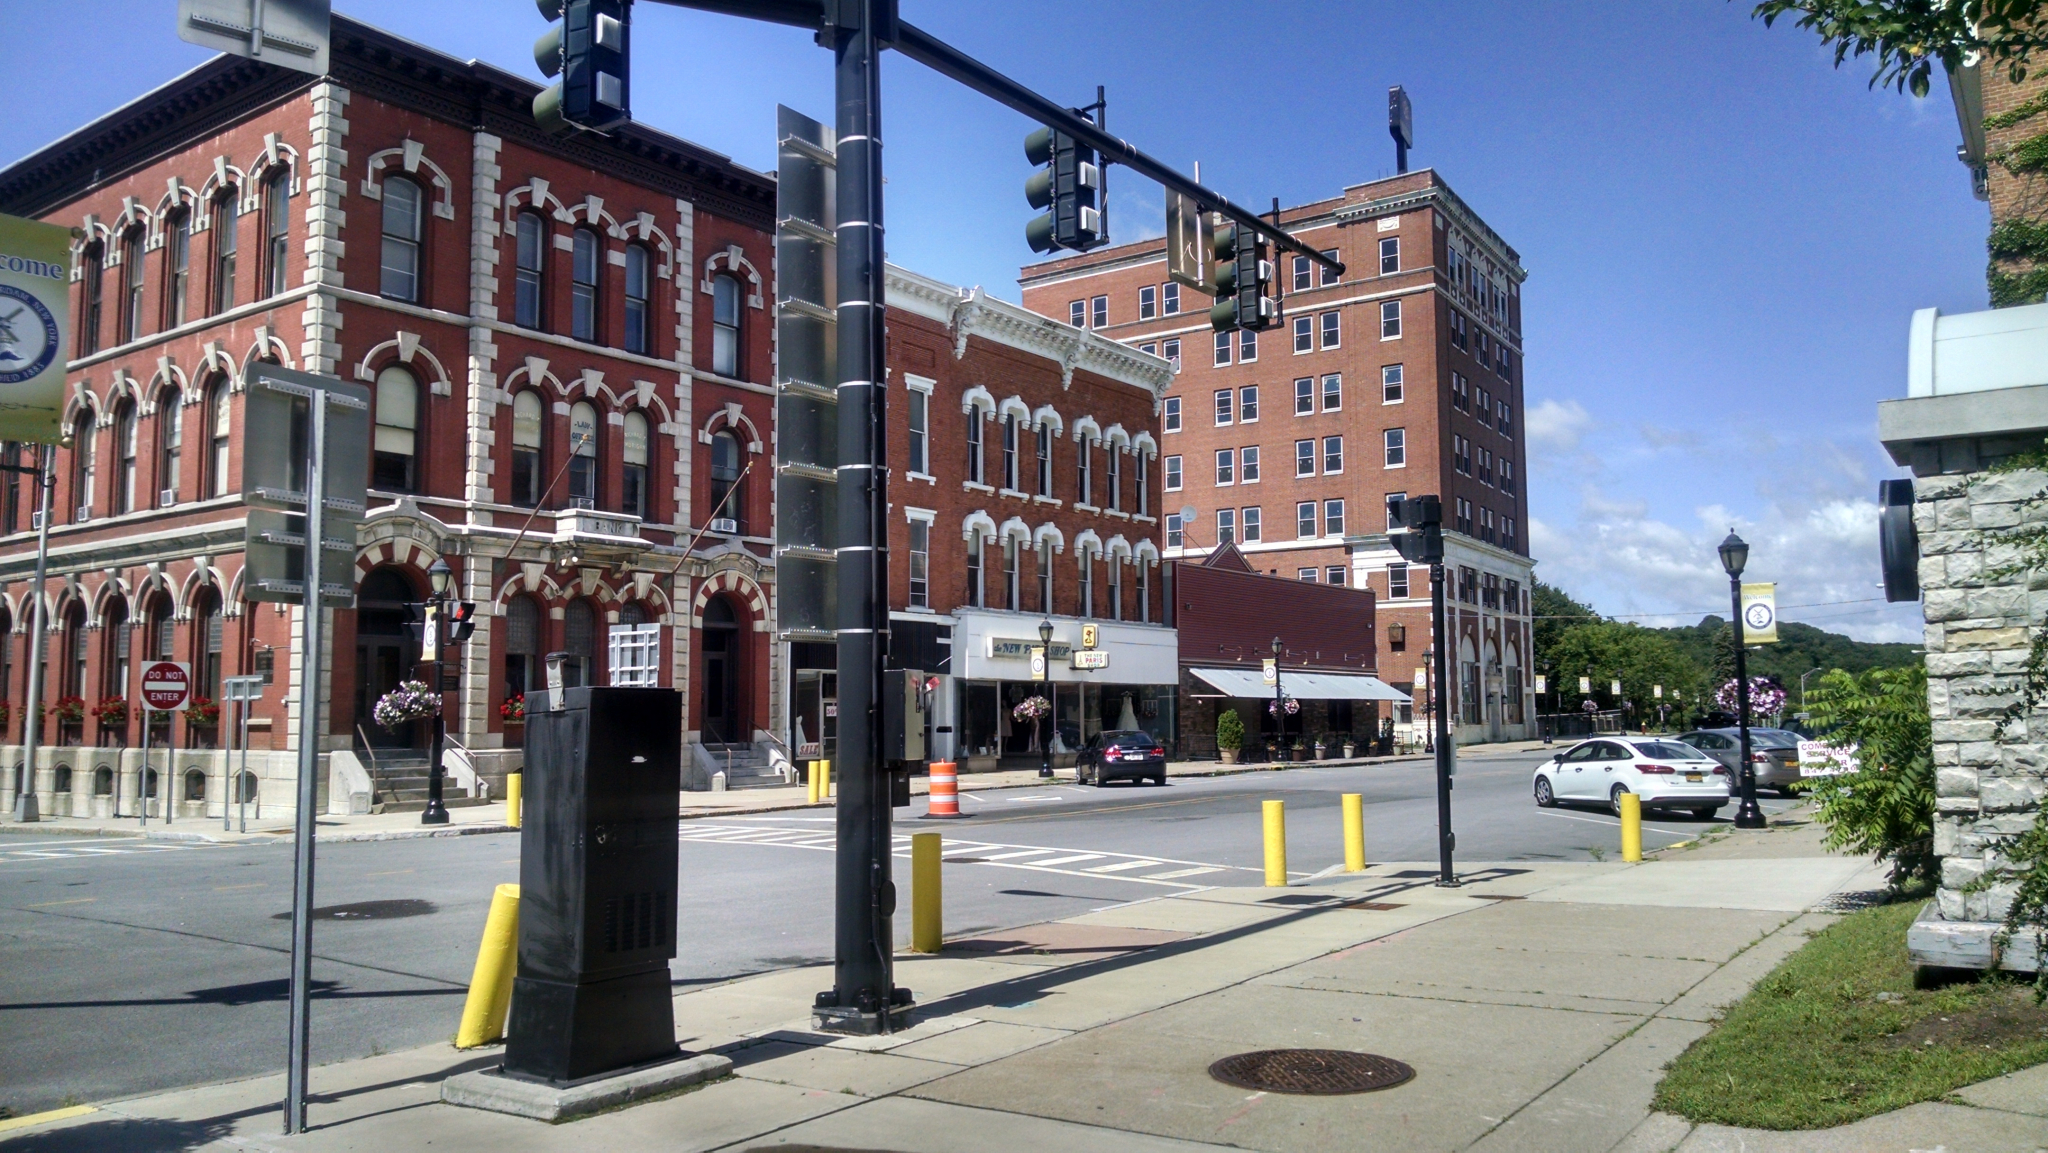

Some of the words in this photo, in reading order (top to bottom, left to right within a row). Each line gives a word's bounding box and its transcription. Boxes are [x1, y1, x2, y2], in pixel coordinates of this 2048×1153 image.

[32, 301, 52, 321] NEW
[47, 322, 57, 347] YORK
[22, 361, 45, 379] 1885
[594, 521, 623, 534] BANK
[1002, 642, 1022, 654] NEW
[1050, 646, 1070, 656] SHOP
[149, 671, 161, 679] DO
[800, 745, 819, 755] SALE
